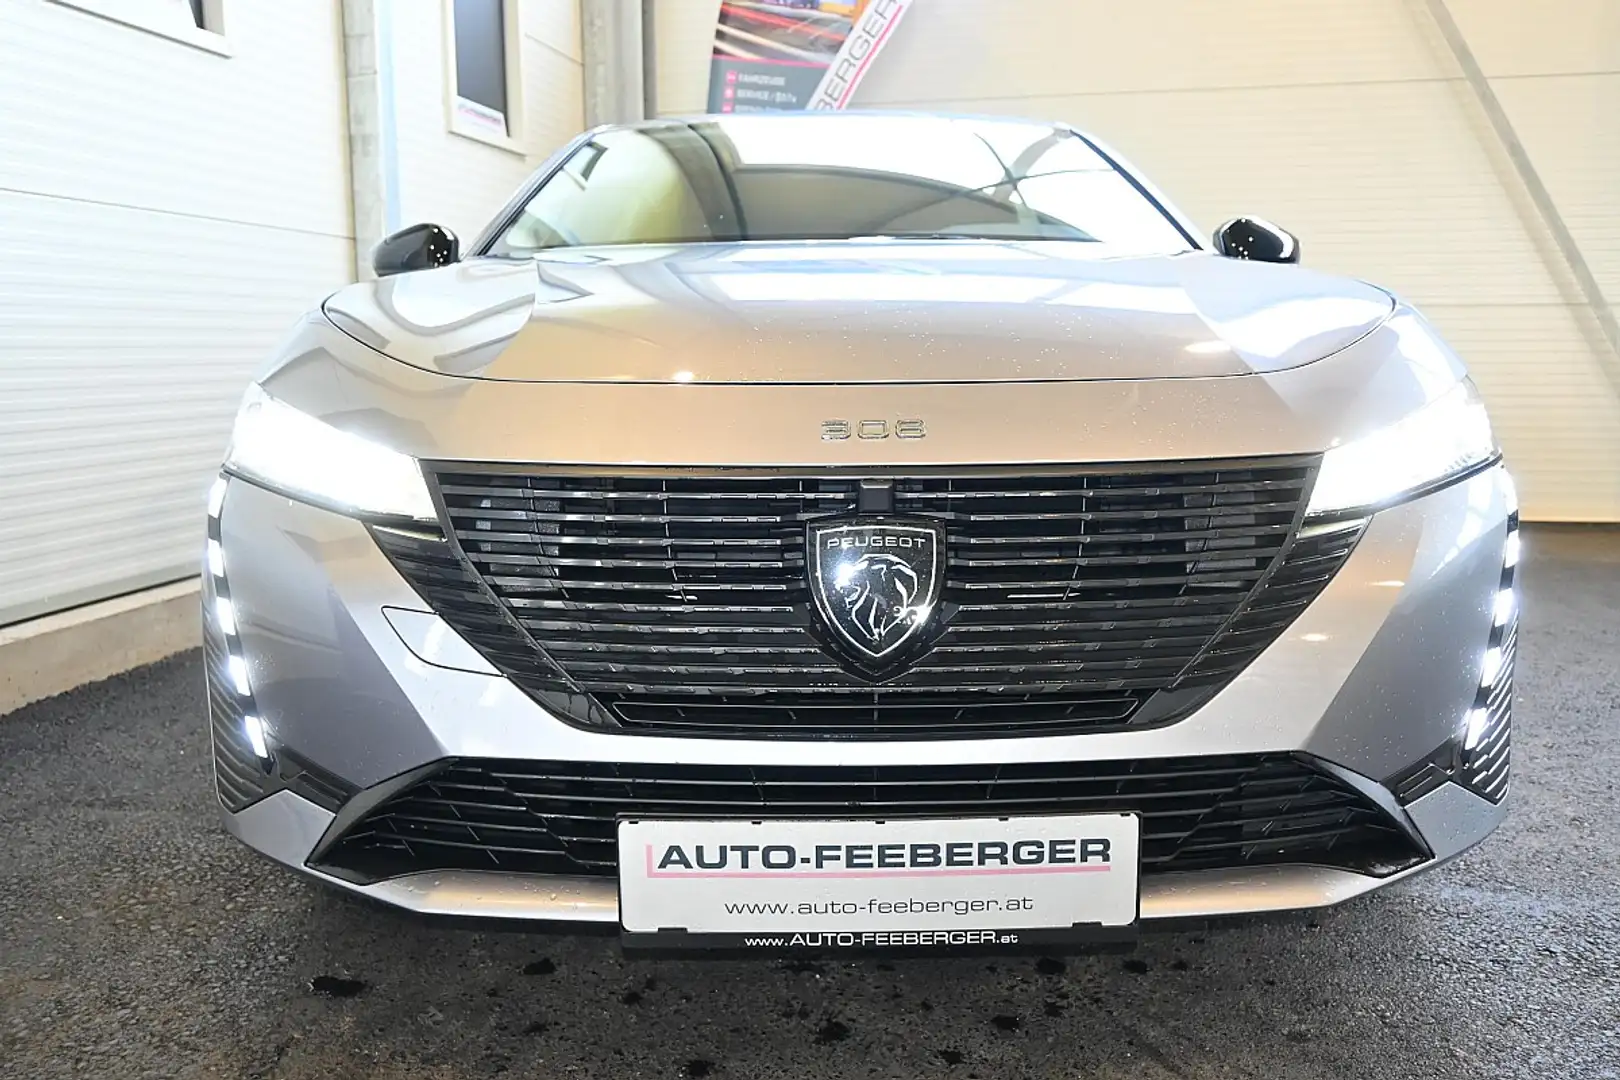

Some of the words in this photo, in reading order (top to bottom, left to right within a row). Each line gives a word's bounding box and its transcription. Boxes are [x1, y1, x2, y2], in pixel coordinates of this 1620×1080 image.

[820, 419, 927, 440] 308
[827, 536, 926, 549] PEUGEOT
[657, 838, 1112, 870] AUTO-FEEBERGER
[724, 895, 1034, 916] www.auto-feeberger.at
[744, 929, 1019, 947] www.AUTO-FEEBERGER.at
